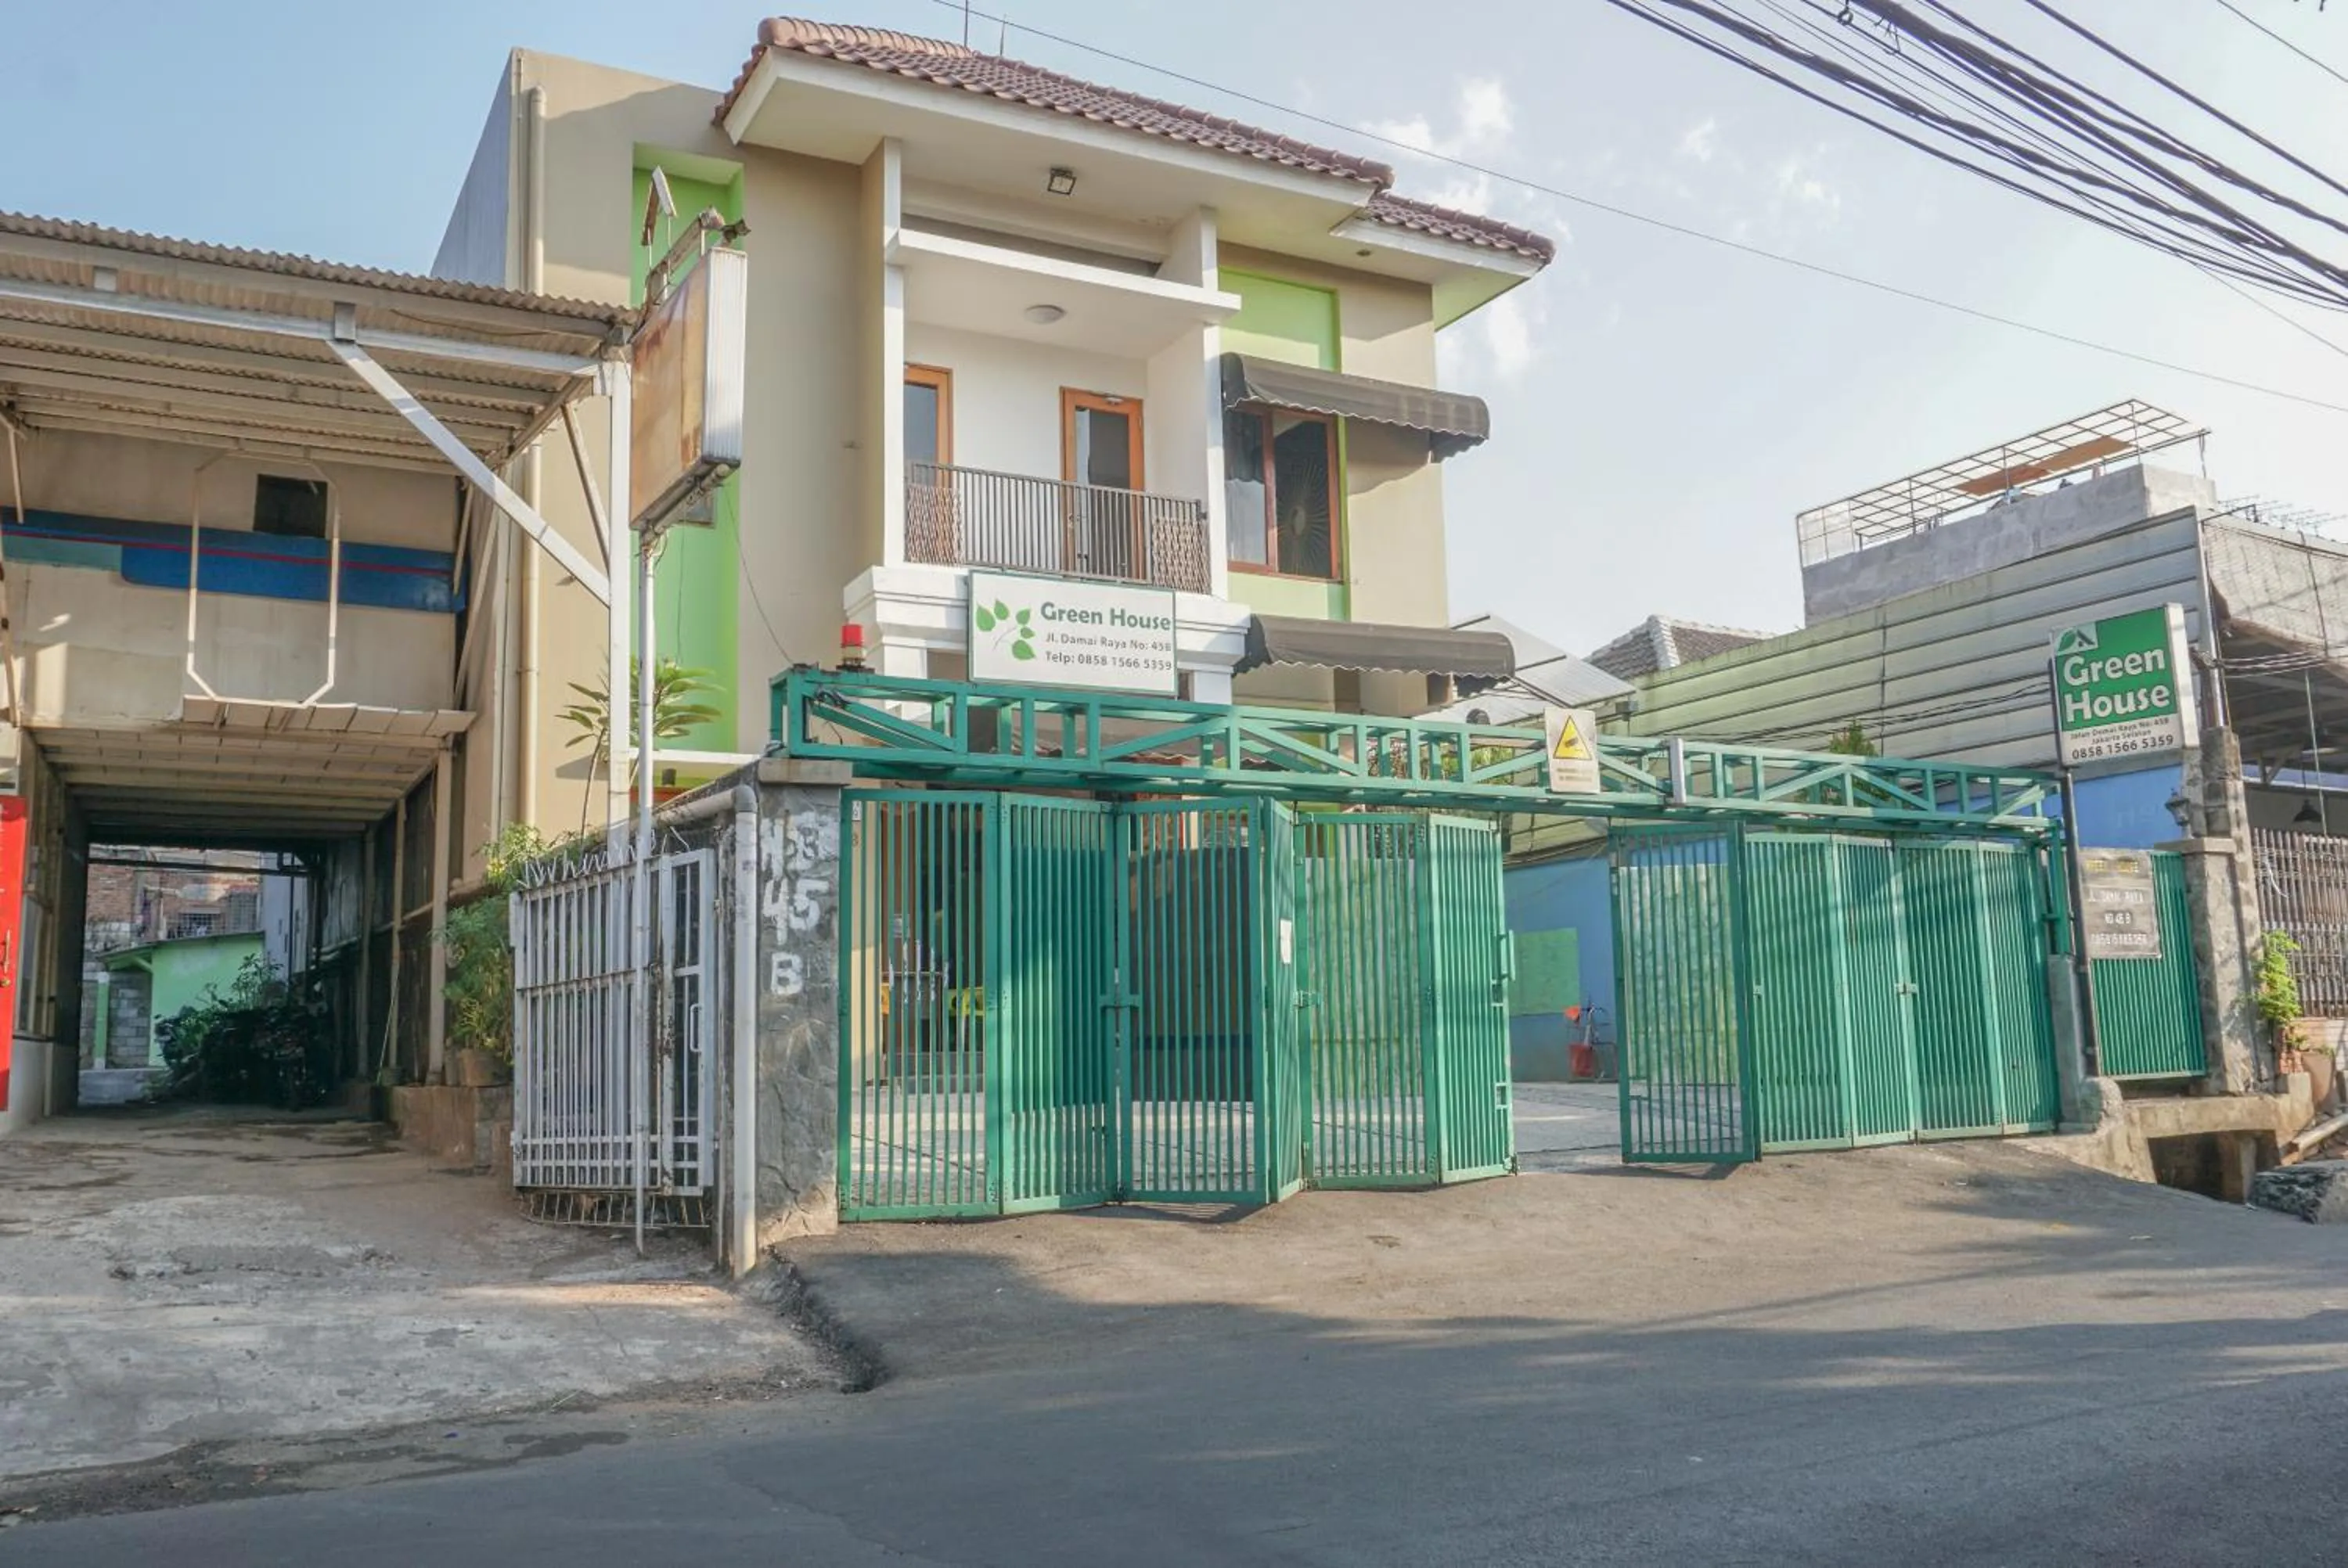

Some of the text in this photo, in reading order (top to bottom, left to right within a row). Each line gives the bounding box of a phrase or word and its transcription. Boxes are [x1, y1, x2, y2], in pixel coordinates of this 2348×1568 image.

[1040, 601, 1171, 631] Green House
[1046, 632, 1058, 642] Jl.
[1061, 634, 1097, 646] Damai
[1100, 635, 1127, 650] Raya
[1046, 651, 1172, 671] Telp: 0858 1566 5359
[2063, 648, 2166, 686] Green
[2064, 685, 2170, 723] House
[2072, 734, 2173, 760] 0858 1566 5359
[762, 878, 830, 945] 45
[771, 952, 803, 995] B
